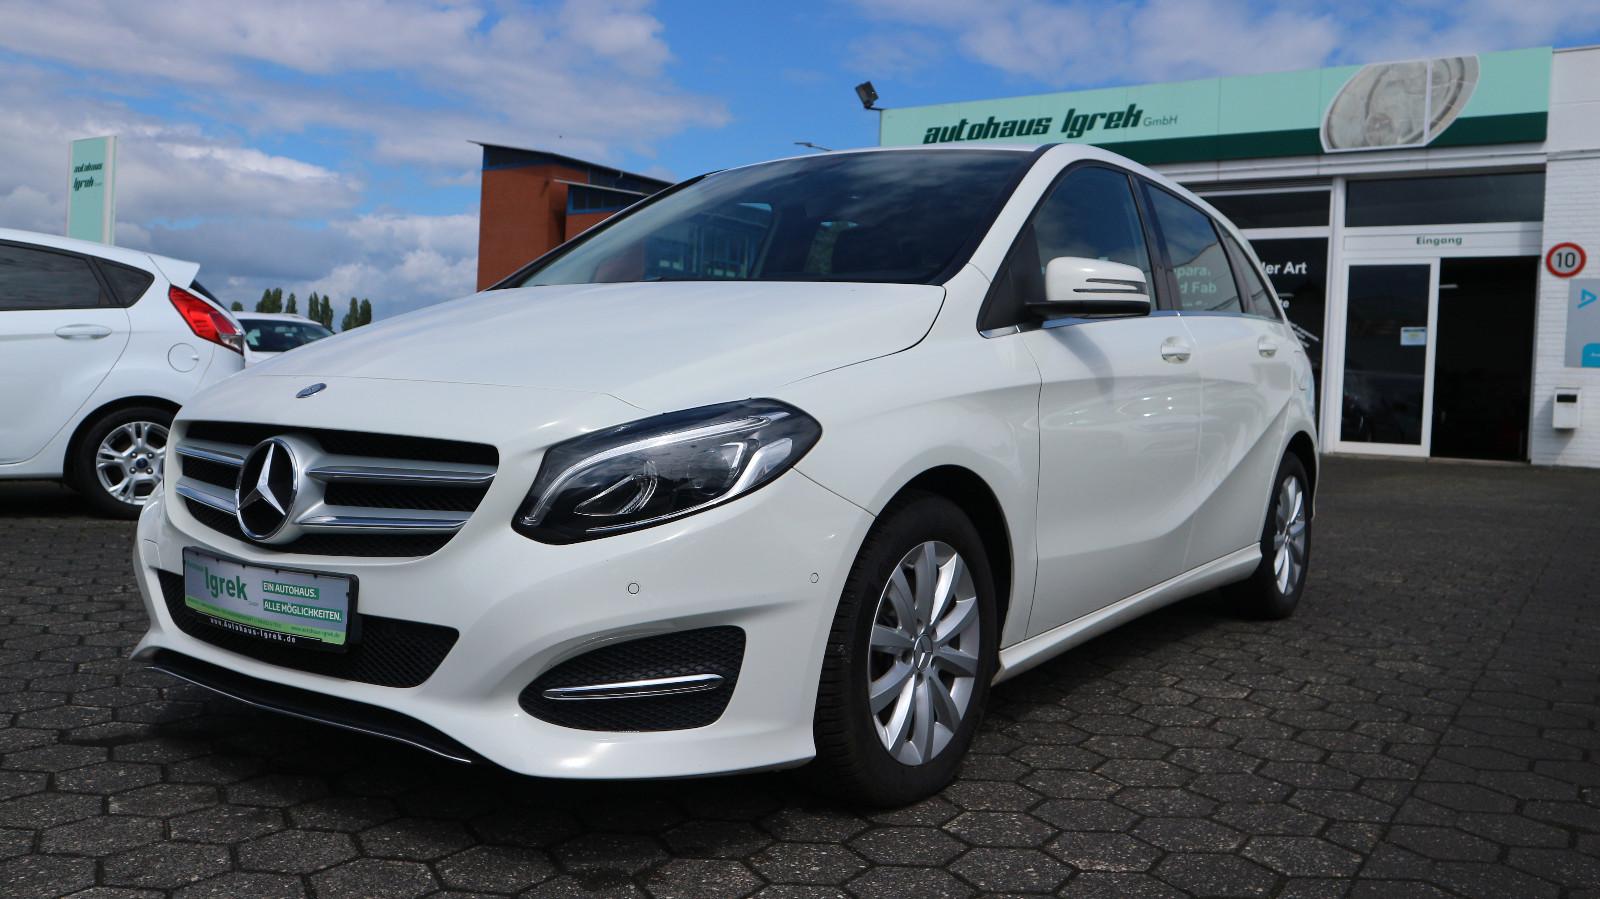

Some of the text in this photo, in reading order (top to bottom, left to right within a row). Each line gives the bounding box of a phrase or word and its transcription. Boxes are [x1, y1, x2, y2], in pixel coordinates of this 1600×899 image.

[923, 103, 1178, 144] autohaus Igrek GmbH
[1416, 235, 1463, 246] Eingang
[1283, 261, 1308, 275] Art
[1556, 252, 1576, 268] 10
[1192, 281, 1217, 294] Fab
[205, 566, 248, 601] Igrek
[263, 582, 317, 598] EIN AUTOHAUS.
[264, 601, 281, 612] ALLE
[281, 603, 342, 621] MÖGLICHKEITEN.
